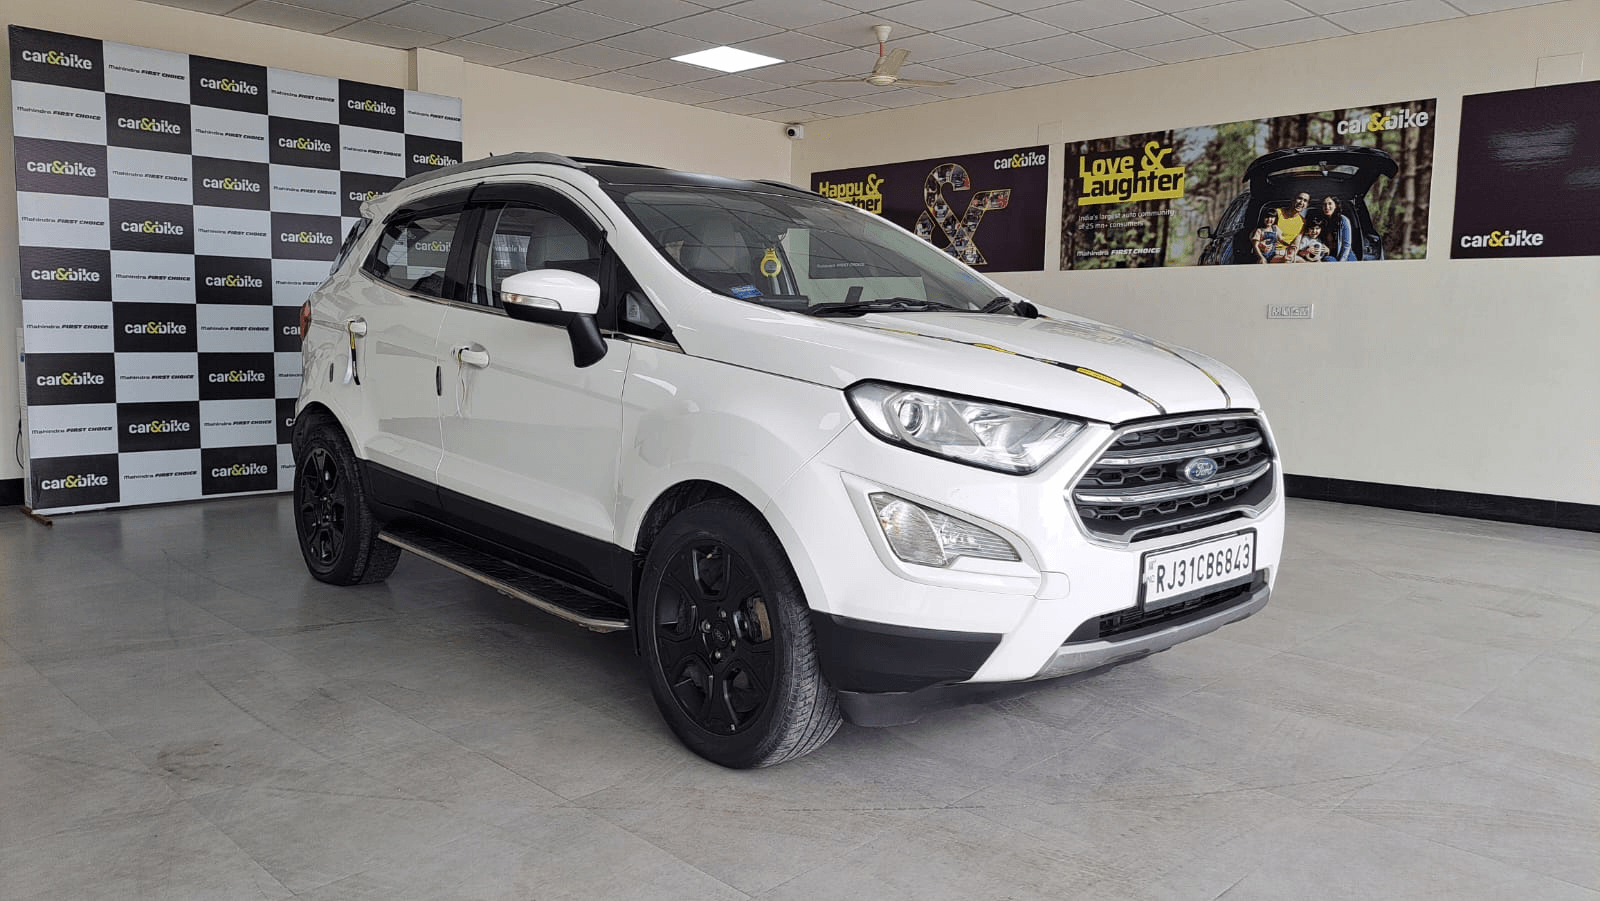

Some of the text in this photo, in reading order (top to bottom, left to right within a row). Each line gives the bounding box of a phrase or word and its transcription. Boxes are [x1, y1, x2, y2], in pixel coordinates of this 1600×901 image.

[23, 50, 92, 70] car&bike
[201, 77, 257, 96] car&bike
[348, 99, 396, 116] car&bike
[118, 117, 180, 135] car&bike
[1337, 108, 1429, 135] car&bike
[279, 137, 331, 153] car&bike
[994, 152, 1046, 170] car&bike
[1079, 141, 1173, 178] Love &
[27, 160, 96, 177] car&bike
[203, 177, 260, 193] car&bike
[819, 173, 885, 199] Happy &
[1078, 170, 1184, 201] Laughter
[1099, 212, 1121, 221] largest
[1137, 209, 1175, 218] community
[121, 220, 183, 236] car&bike
[281, 231, 333, 245] car&bike
[1460, 229, 1544, 248] car&bike
[1076, 249, 1109, 257] Mahindra
[1133, 247, 1161, 255] CHOICE
[32, 267, 99, 282] car&bike
[206, 274, 262, 288] car&bike
[125, 321, 186, 335] car&bike
[37, 371, 103, 386] car&bike
[209, 369, 265, 383] car&bike
[129, 419, 189, 434] car&bike
[212, 462, 267, 478] car&bike
[42, 473, 107, 490] car&bike
[1156, 543, 1250, 593] RJ31CB6843
